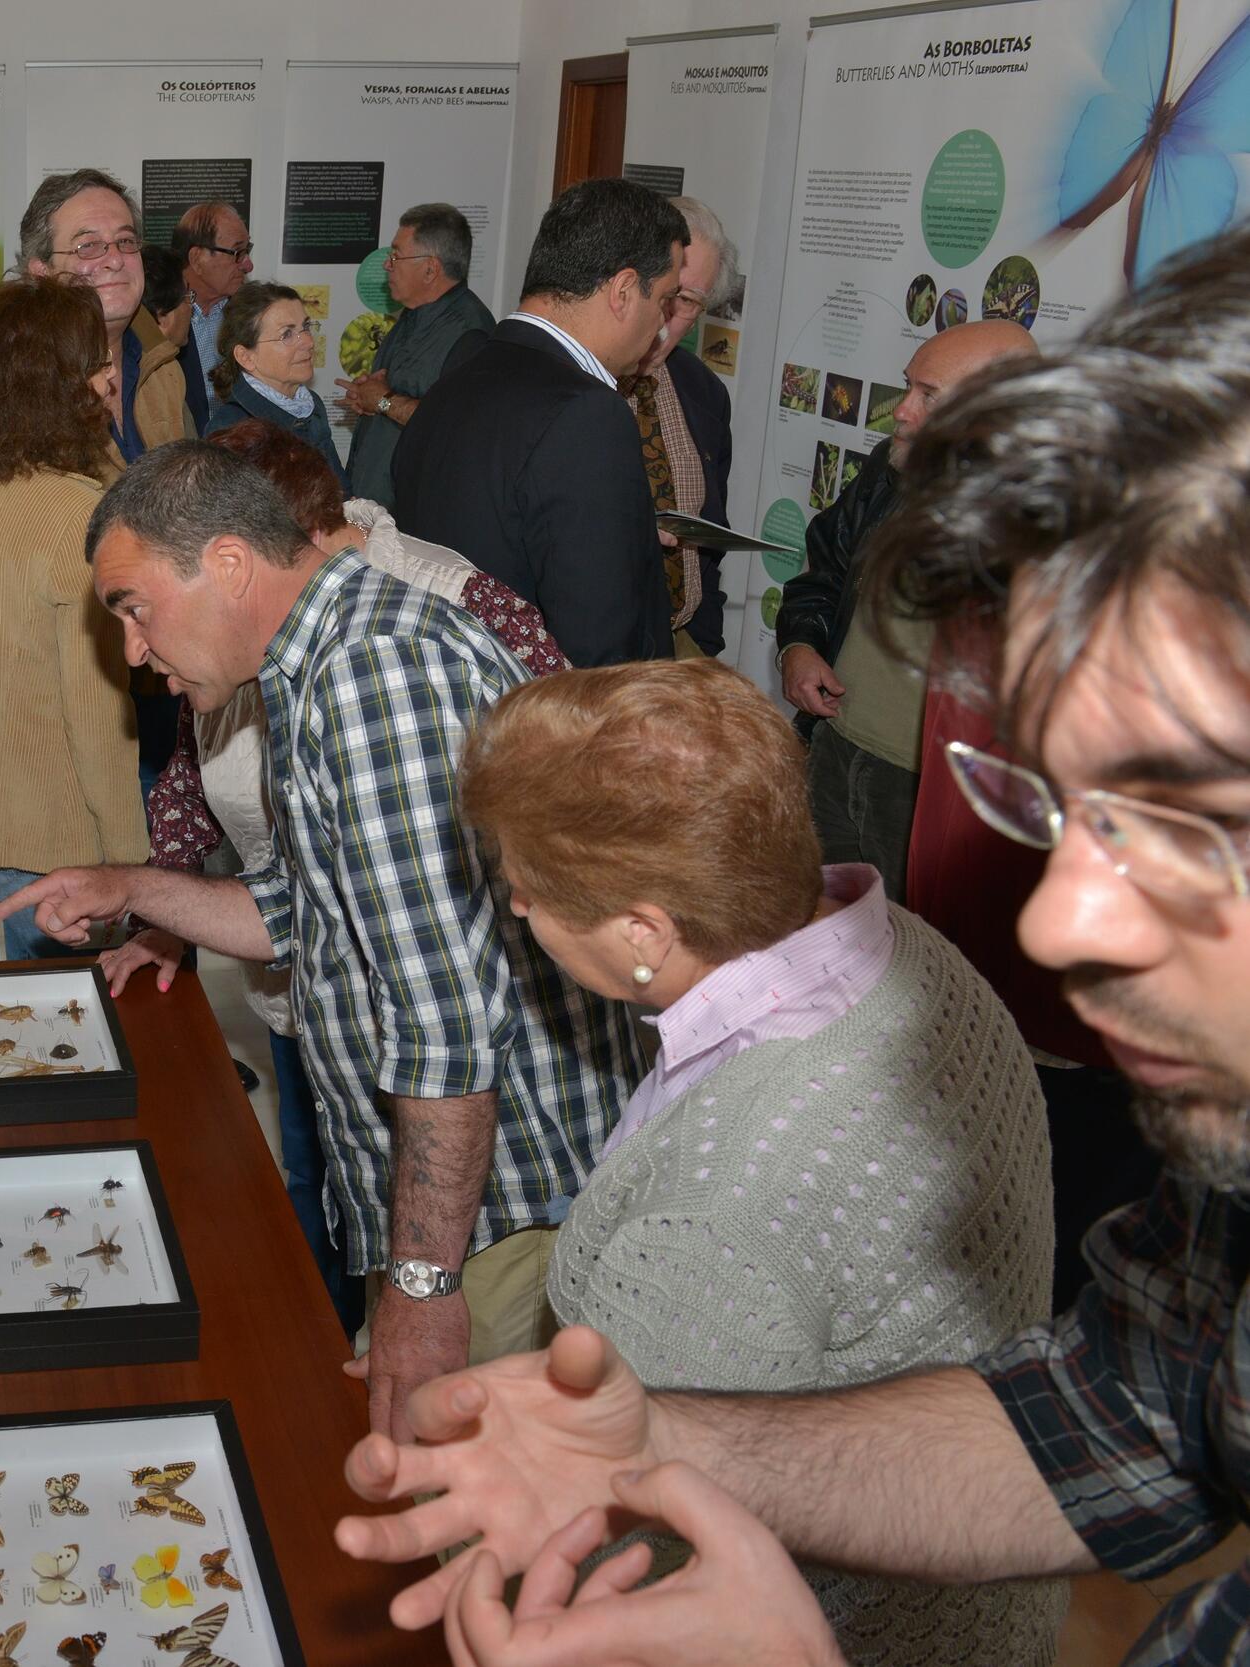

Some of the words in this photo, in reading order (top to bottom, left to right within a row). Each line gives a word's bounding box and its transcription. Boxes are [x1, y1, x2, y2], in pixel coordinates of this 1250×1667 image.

[943, 35, 1032, 58] BORBOLETAS
[685, 67, 714, 79] MOSCAS
[715, 68, 719, 78] E
[720, 66, 769, 78] MOSQUITOS
[836, 65, 895, 83] BUTTERFLIES
[898, 64, 925, 79] AND
[405, 86, 457, 94] FORMIGAS
[466, 86, 510, 94] ABELHAS
[686, 83, 701, 93] AND
[702, 82, 746, 94] MOSQUITOES
[395, 97, 419, 105] ANTS
[422, 97, 443, 105] AND
[446, 97, 464, 105] BEES
